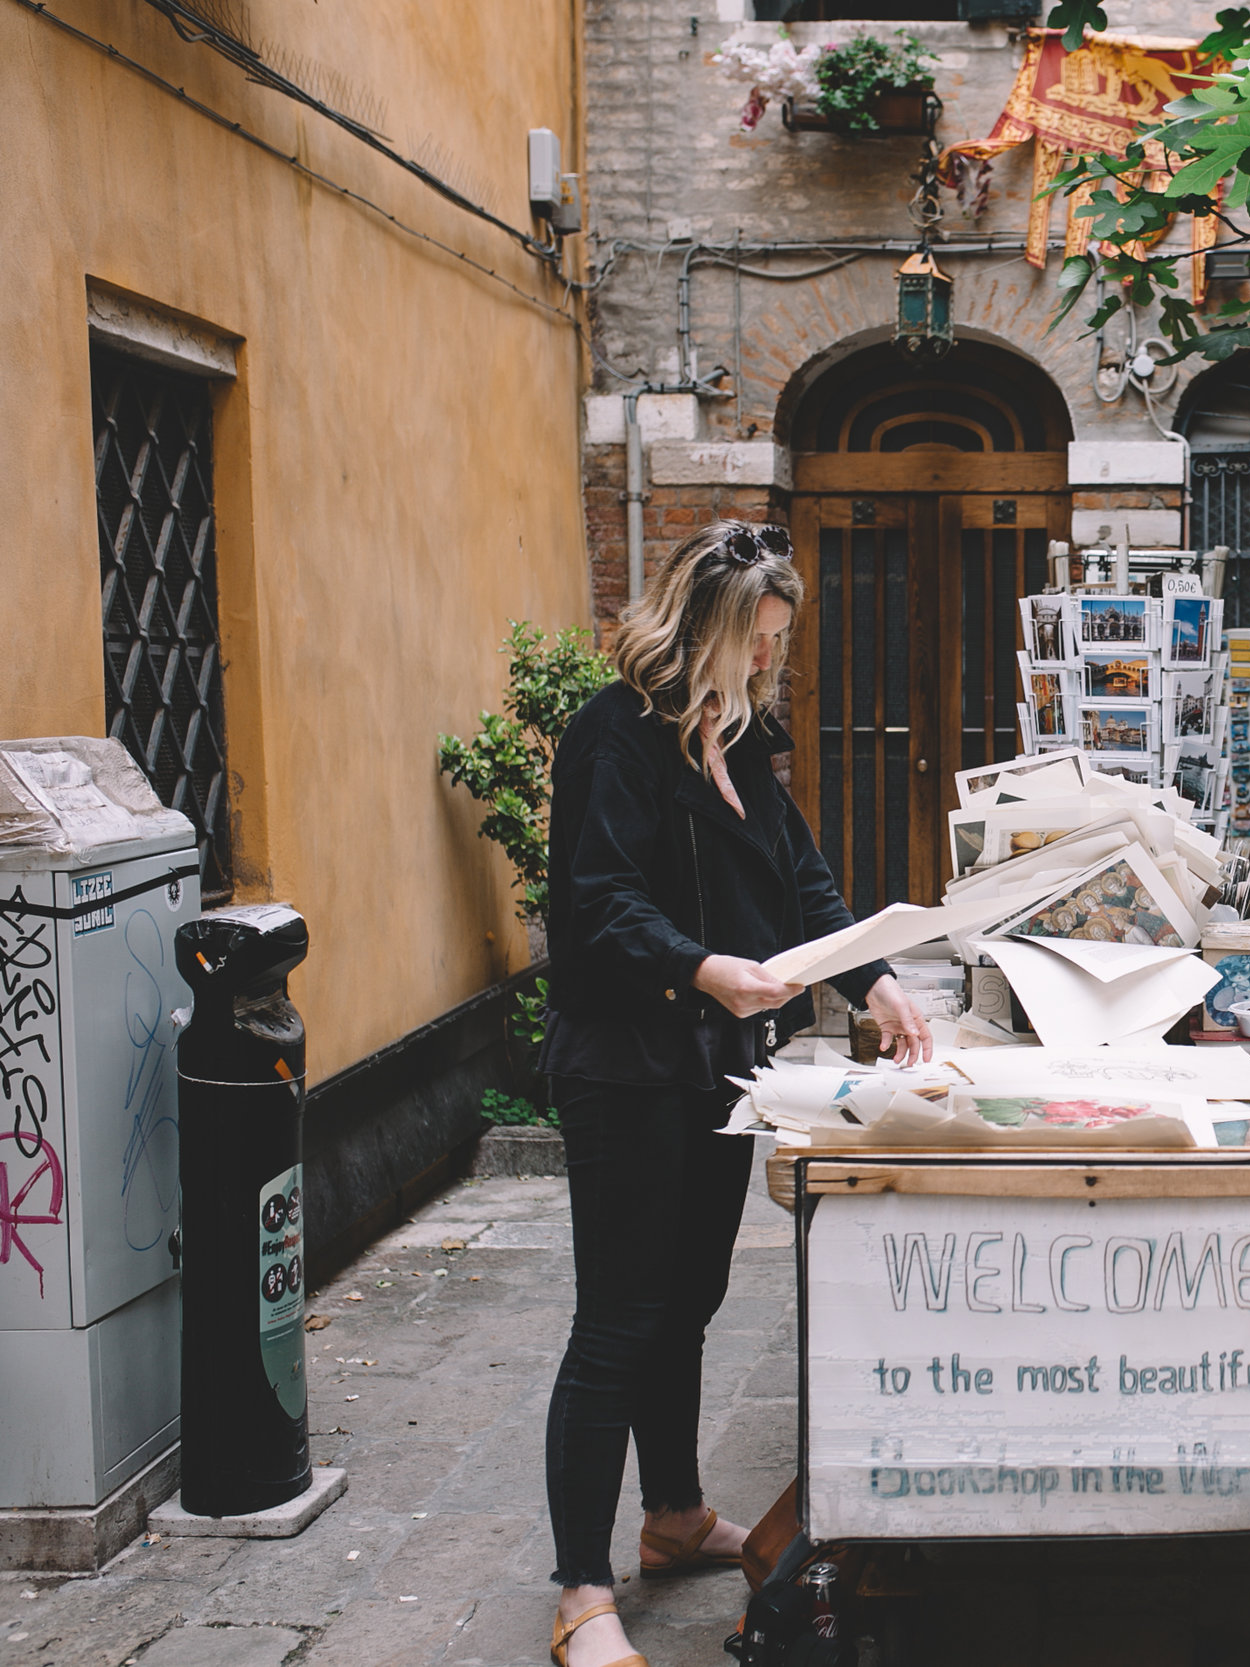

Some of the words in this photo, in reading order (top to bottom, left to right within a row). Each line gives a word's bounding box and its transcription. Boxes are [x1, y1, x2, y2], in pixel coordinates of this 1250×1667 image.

[1167, 578, 1197, 594] 0,50€
[874, 1358, 911, 1396] to
[927, 1353, 993, 1394] the
[1016, 1356, 1101, 1393] most
[1071, 1448, 1103, 1495] in
[1111, 1446, 1166, 1495] the
